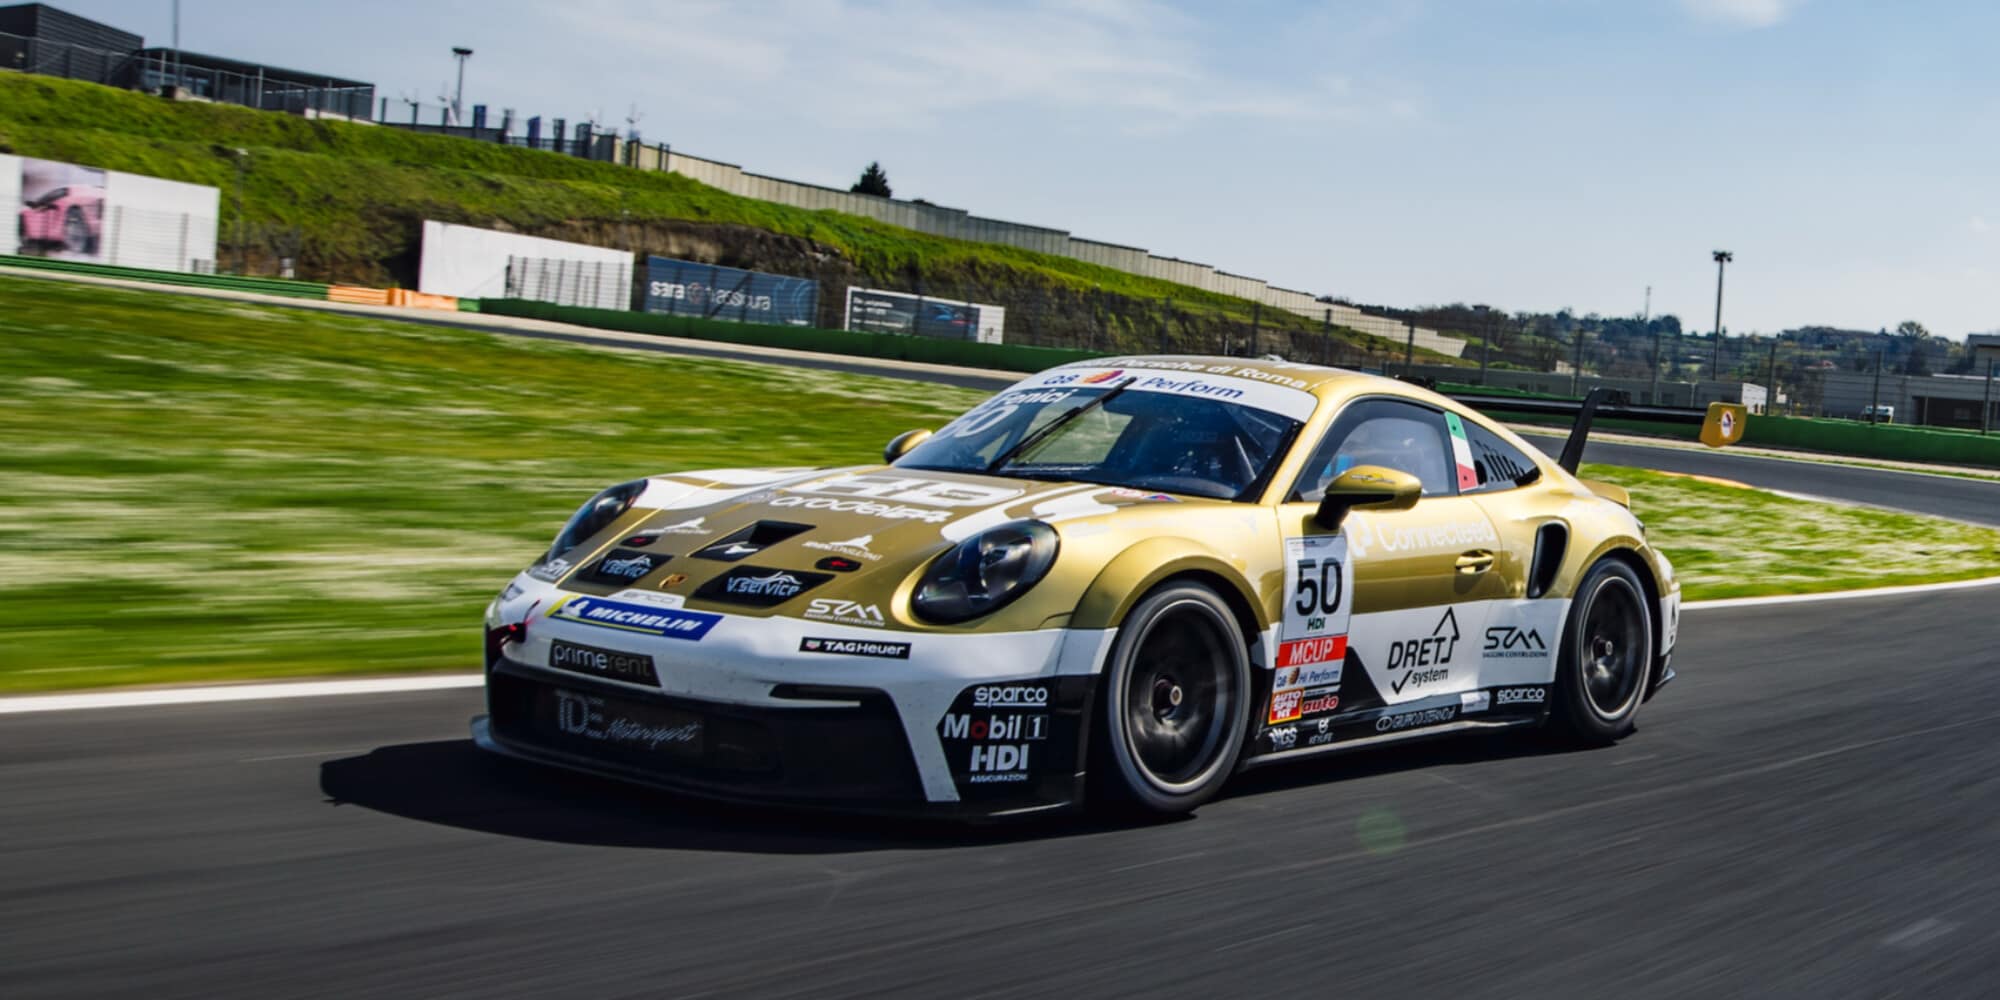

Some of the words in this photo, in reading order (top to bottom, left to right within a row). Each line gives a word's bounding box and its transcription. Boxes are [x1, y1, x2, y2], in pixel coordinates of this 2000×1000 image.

[650, 281, 685, 299] sara
[1207, 361, 1232, 375] di
[1235, 364, 1305, 388] Roma
[1142, 375, 1244, 399] Perform
[1296, 557, 1342, 616] 50
[588, 607, 703, 632] MICHELIN
[1307, 617, 1326, 631] HDI
[553, 644, 650, 677] primerent
[1289, 639, 1334, 665] MCUP
[1309, 669, 1339, 682] Perform
[1411, 668, 1449, 687] system
[974, 686, 1048, 708] sparco
[1274, 690, 1302, 703] AUTO
[1303, 695, 1339, 714] auto
[1497, 688, 1545, 704] sparco
[943, 713, 1022, 739] Mobil
[969, 744, 1029, 772] HDI
